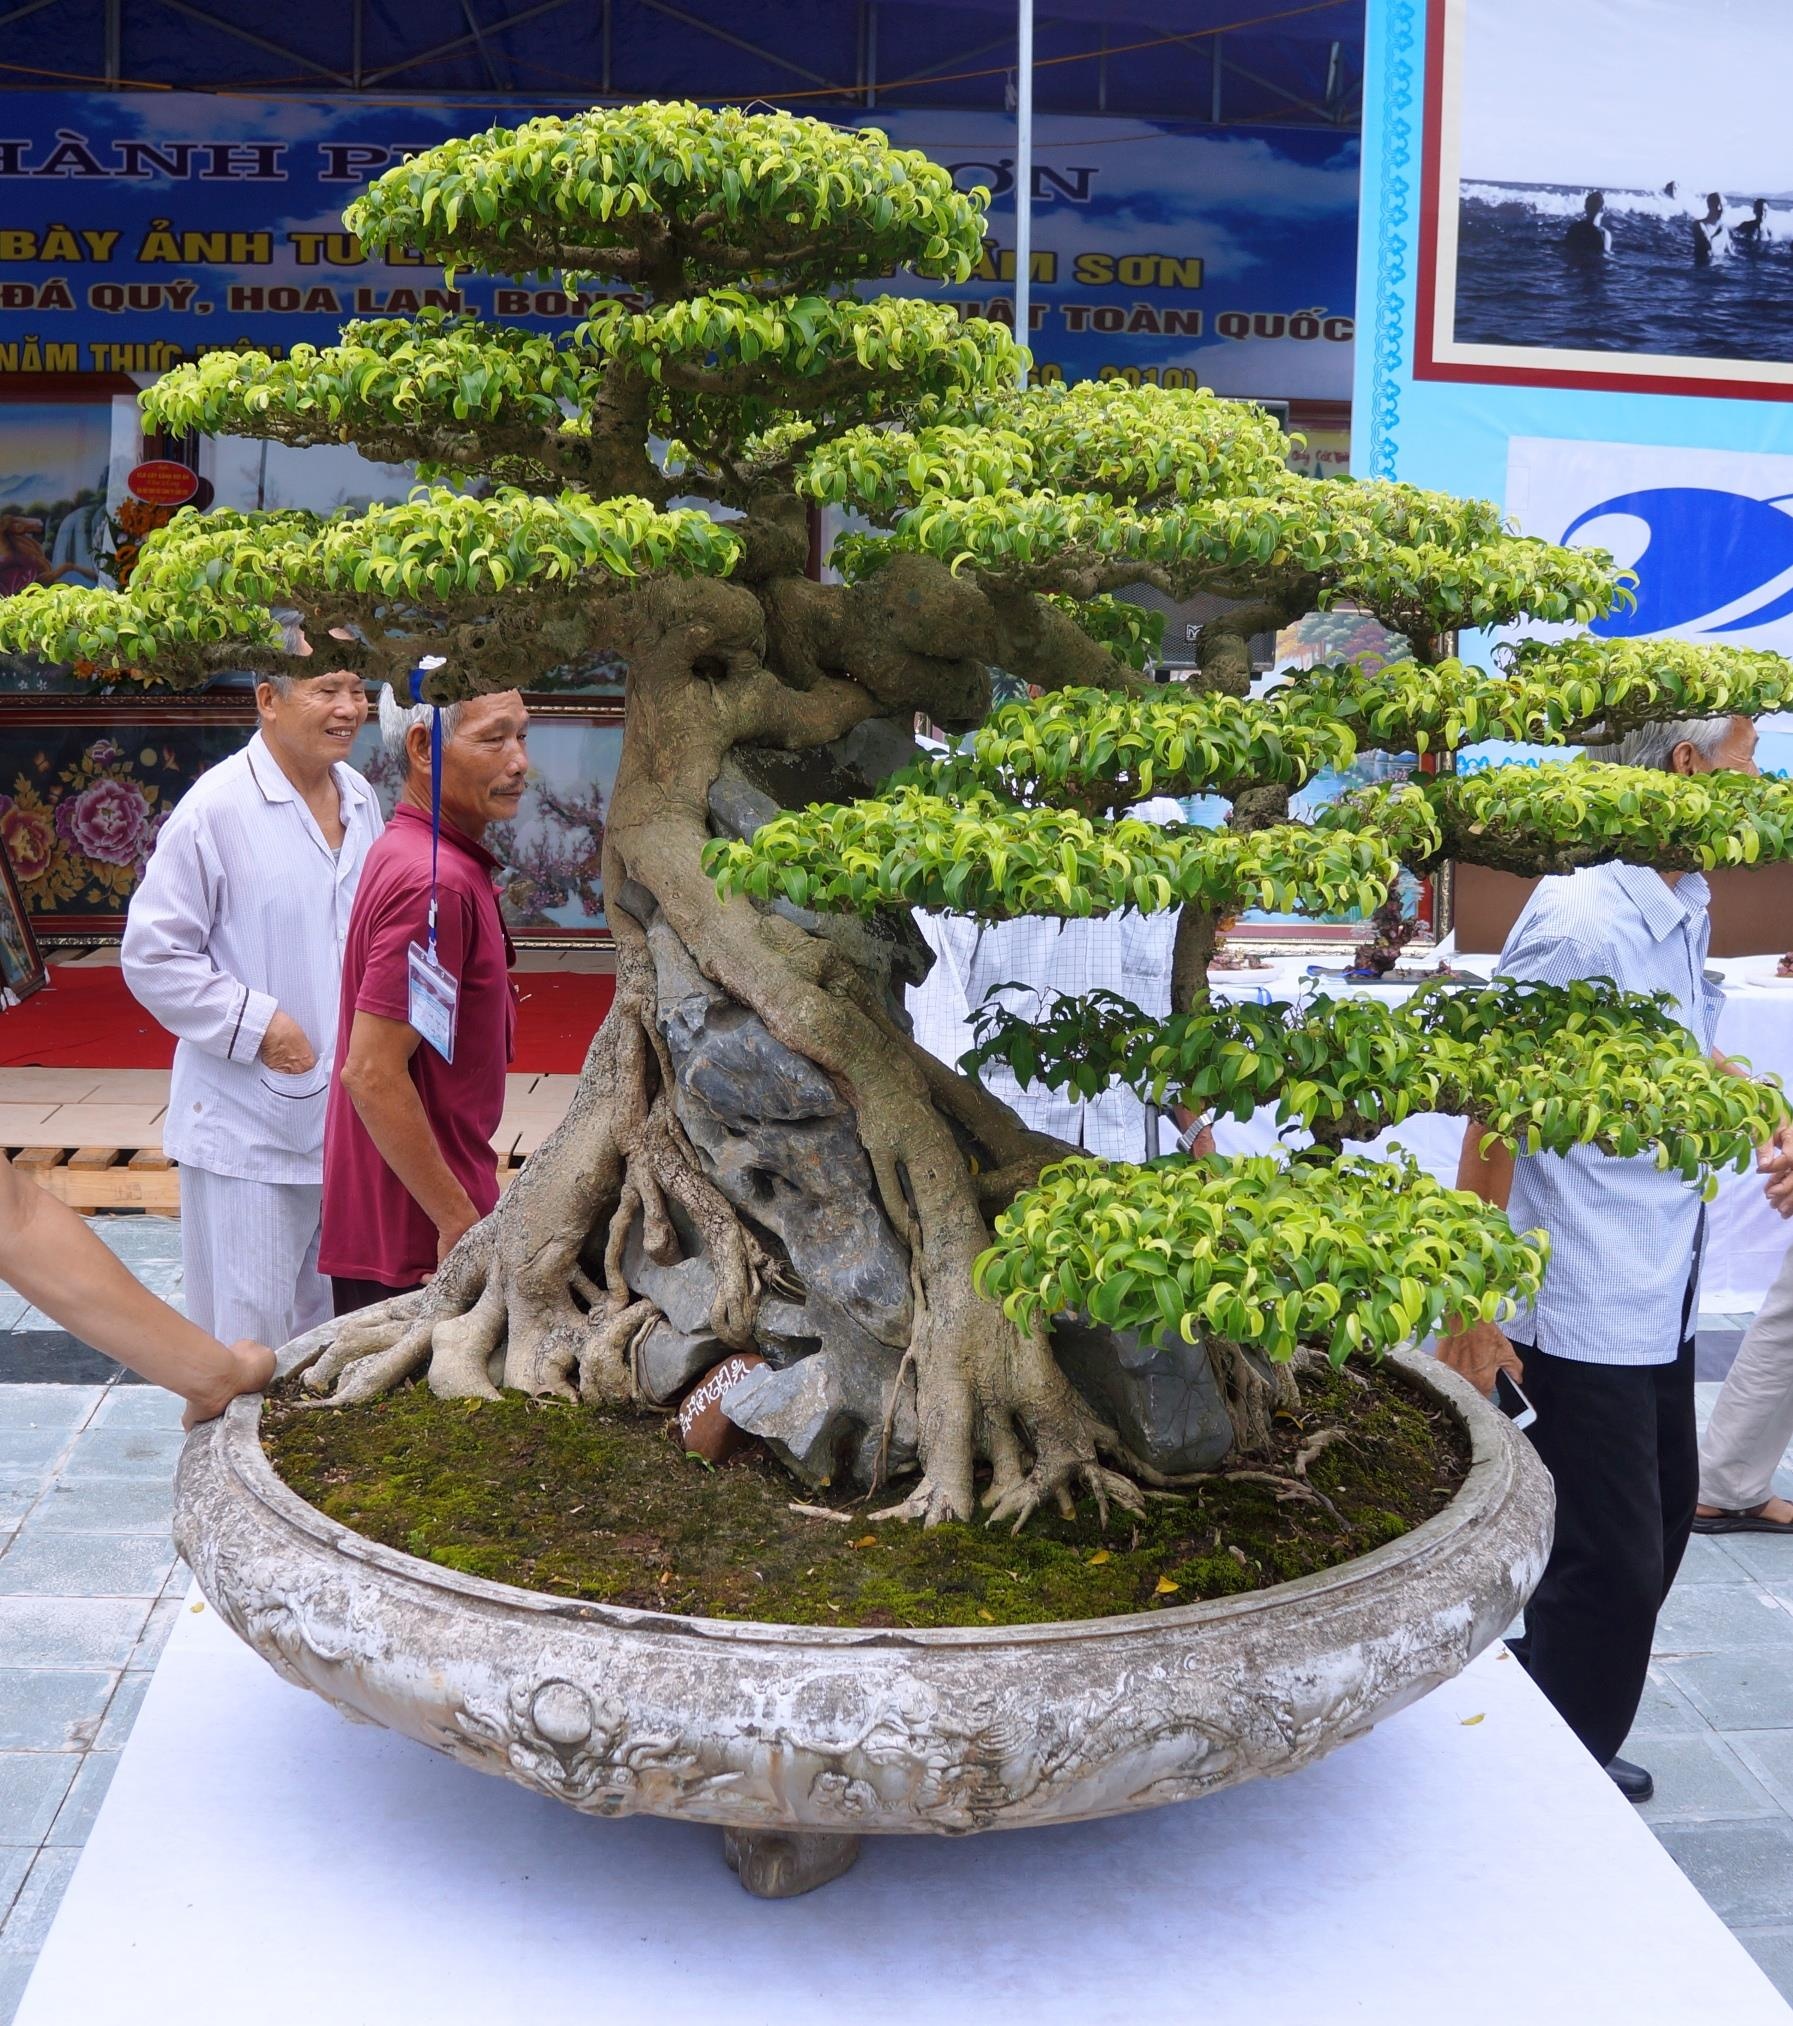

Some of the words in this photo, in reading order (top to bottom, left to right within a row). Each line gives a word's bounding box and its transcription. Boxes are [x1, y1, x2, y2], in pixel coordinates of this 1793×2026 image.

[0, 223, 121, 264] BÀY
[138, 218, 273, 265] ẢNH
[1073, 253, 1204, 289] SƠN
[0, 278, 76, 311] ĐÁ
[88, 279, 215, 314] QUÝ,
[228, 284, 343, 313] HOA
[354, 286, 481, 316] LAN,
[1060, 301, 1202, 336] TOÀN
[1214, 307, 1354, 342] QUỐC
[0, 334, 79, 372] NĂM
